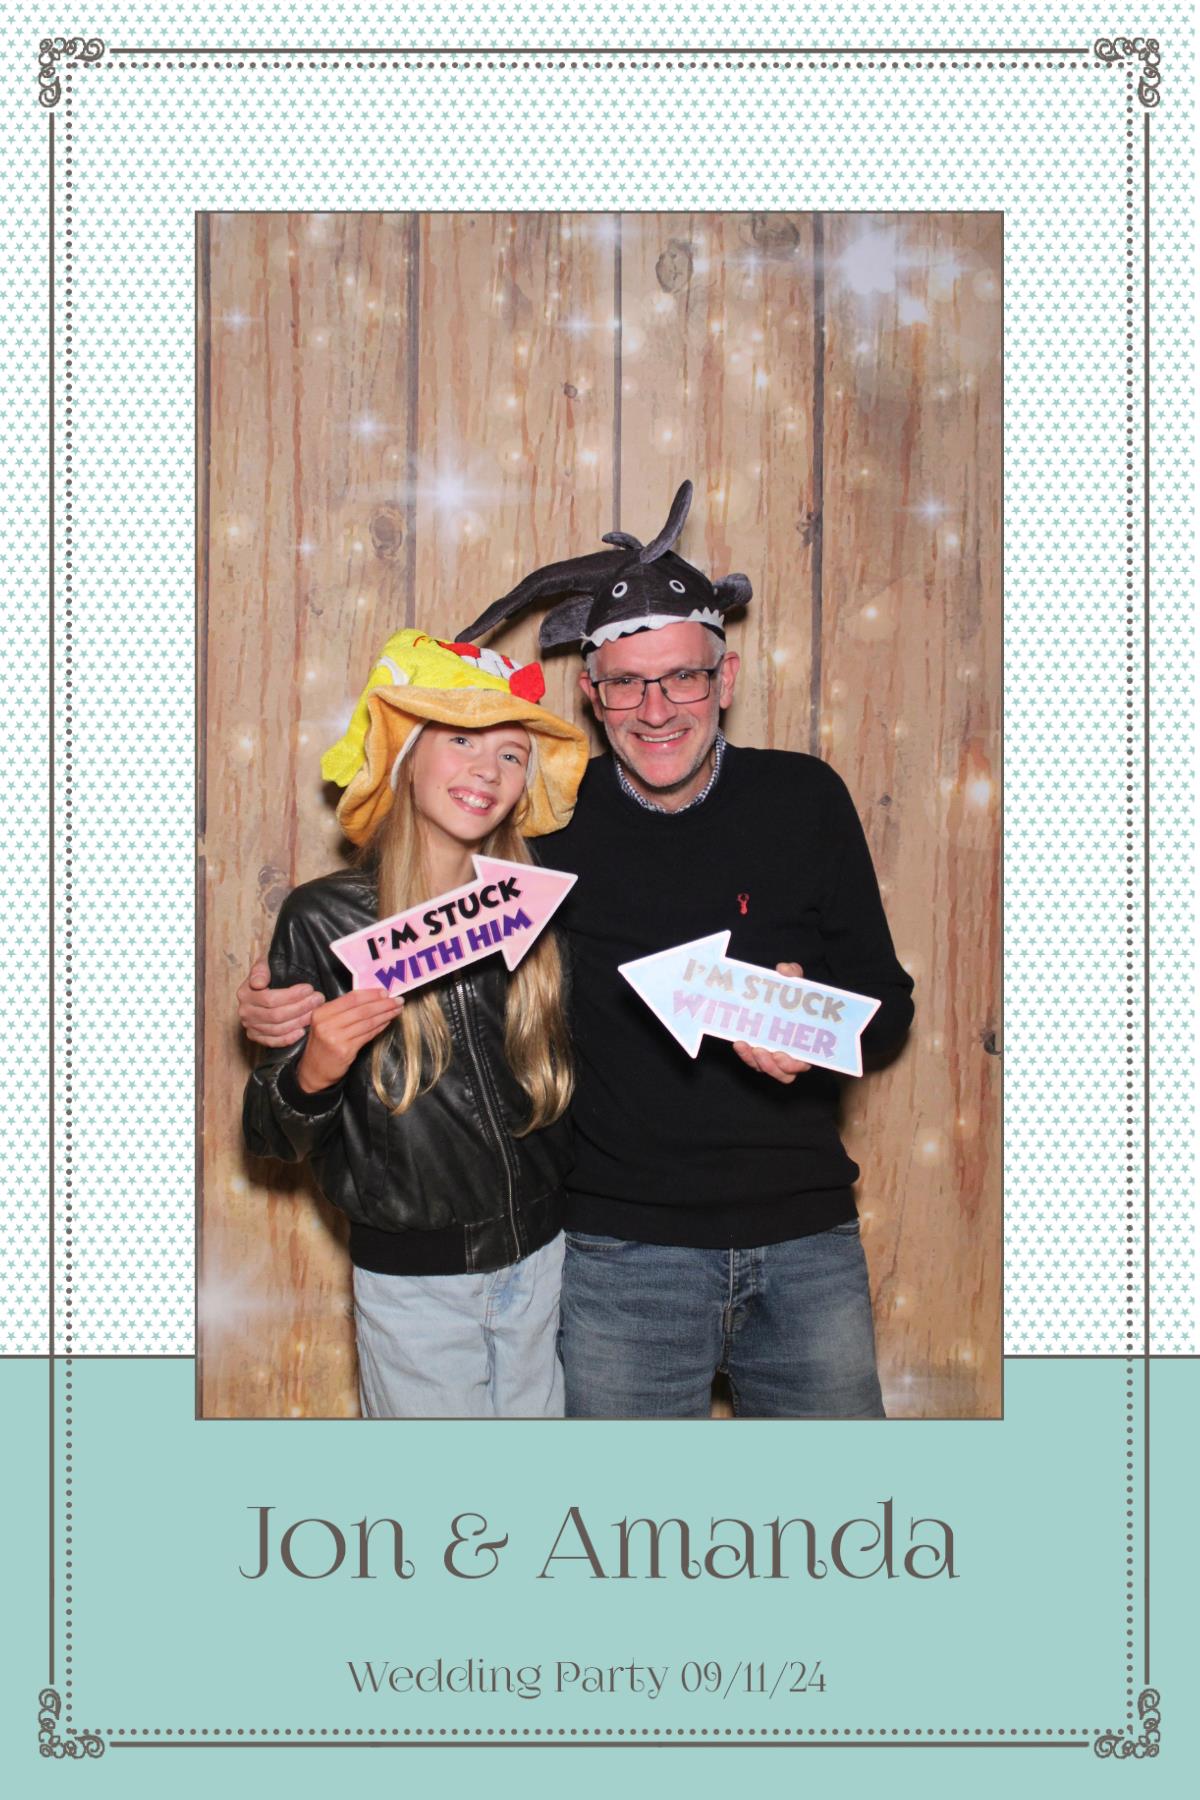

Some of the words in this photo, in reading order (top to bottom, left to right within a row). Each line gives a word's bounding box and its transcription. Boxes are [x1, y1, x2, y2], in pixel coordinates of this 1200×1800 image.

[366, 922, 419, 961] I'M
[422, 876, 522, 936] STUCK
[374, 938, 465, 991] WITH
[466, 907, 534, 952] HIM
[672, 988, 763, 1038] WITH
[768, 1016, 837, 1058] HER
[682, 958, 734, 993] I'M
[742, 974, 846, 1023] STUCK
